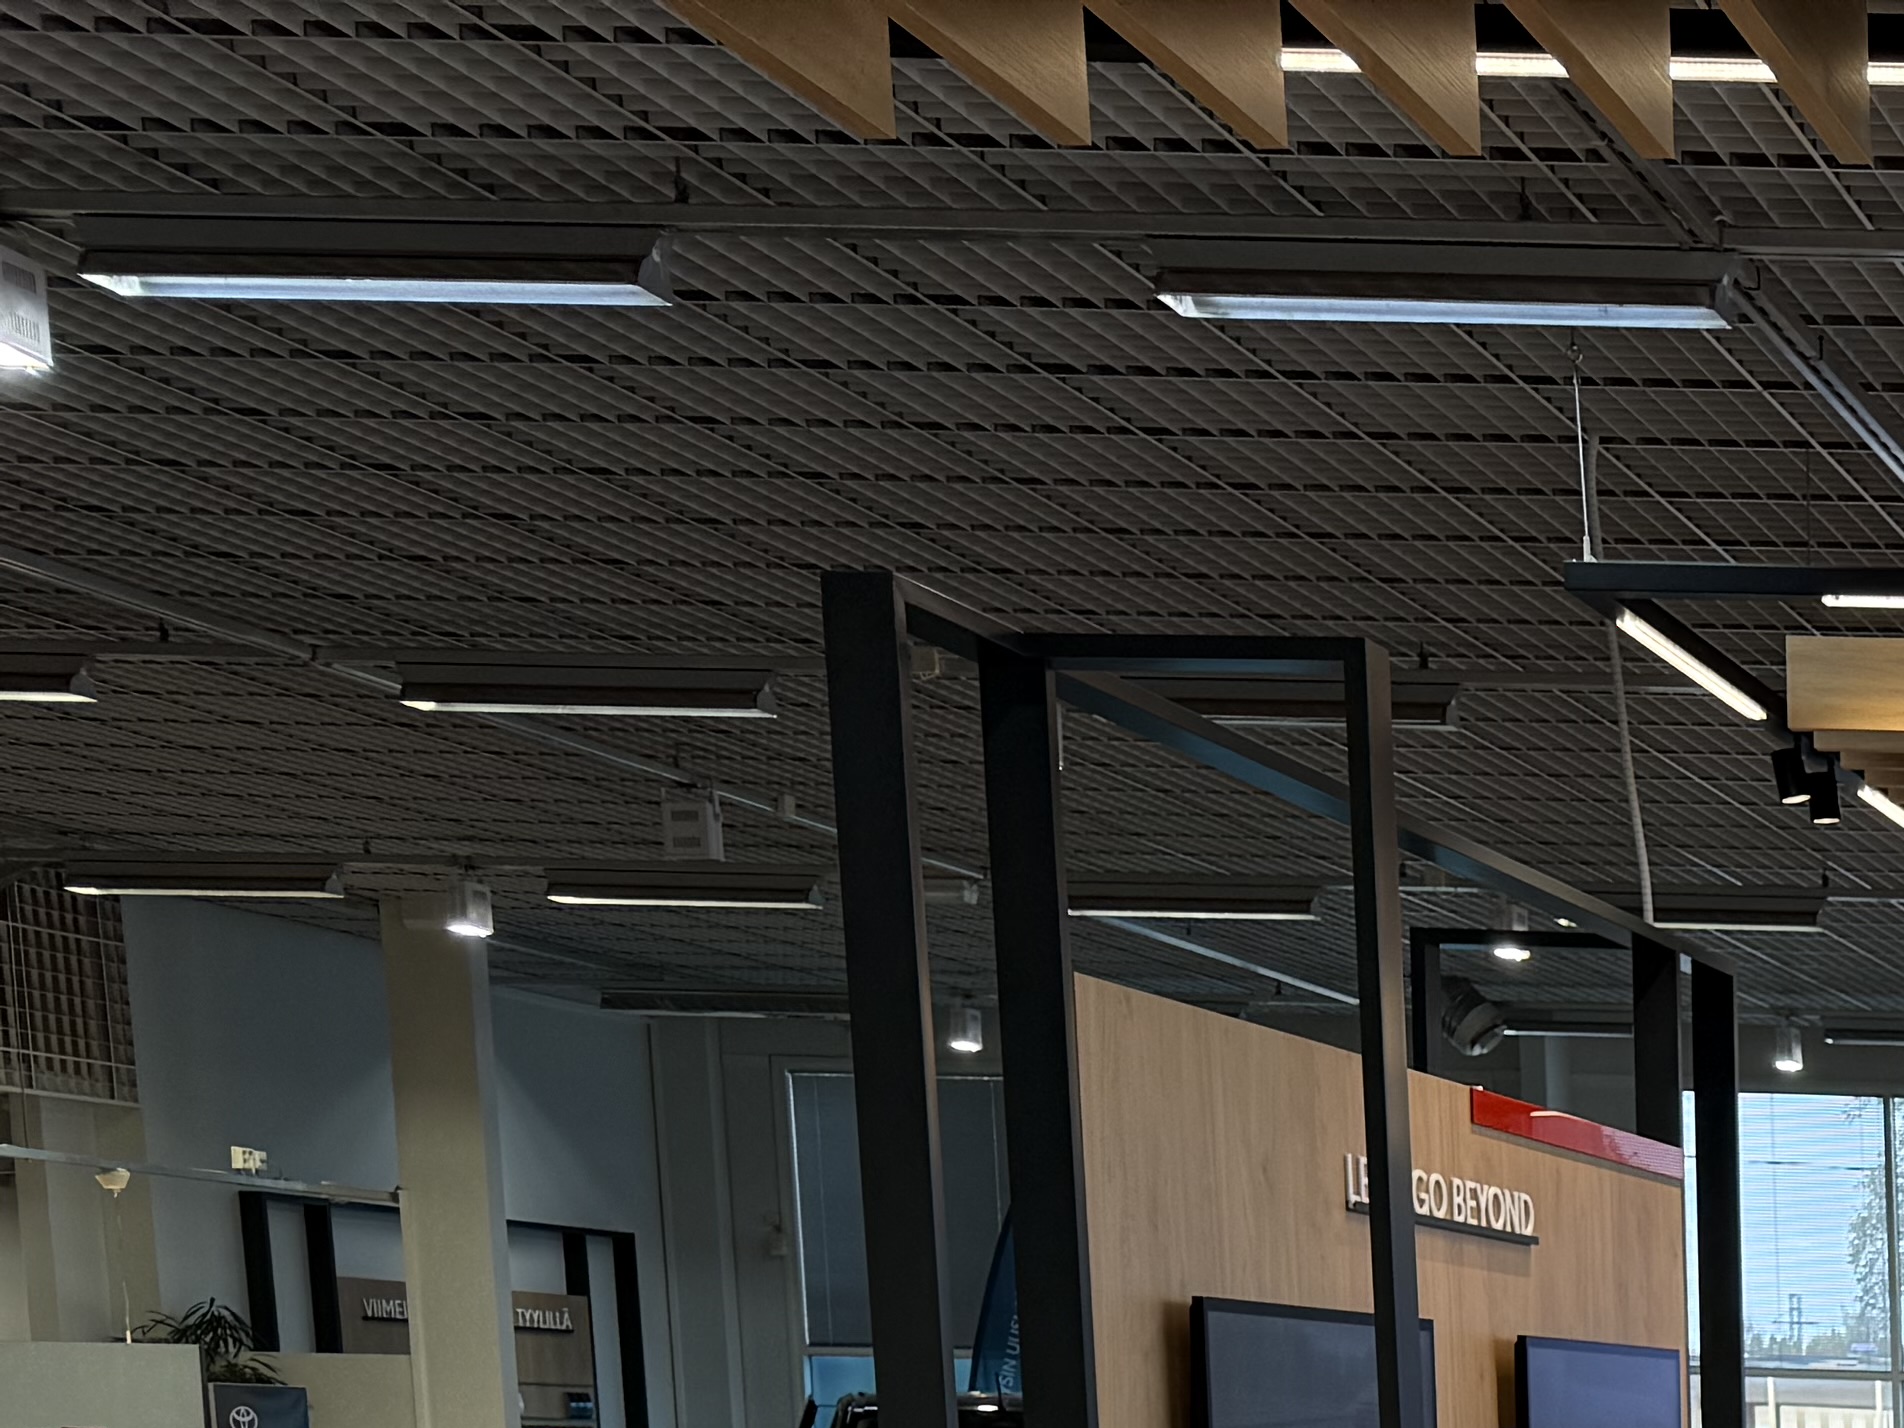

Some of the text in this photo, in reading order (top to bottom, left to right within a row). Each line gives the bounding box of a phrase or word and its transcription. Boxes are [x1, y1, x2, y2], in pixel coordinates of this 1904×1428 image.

[1412, 1168, 1448, 1219] GO
[1450, 1176, 1535, 1236] BEYOND
[362, 1298, 408, 1319] VIIMEI
